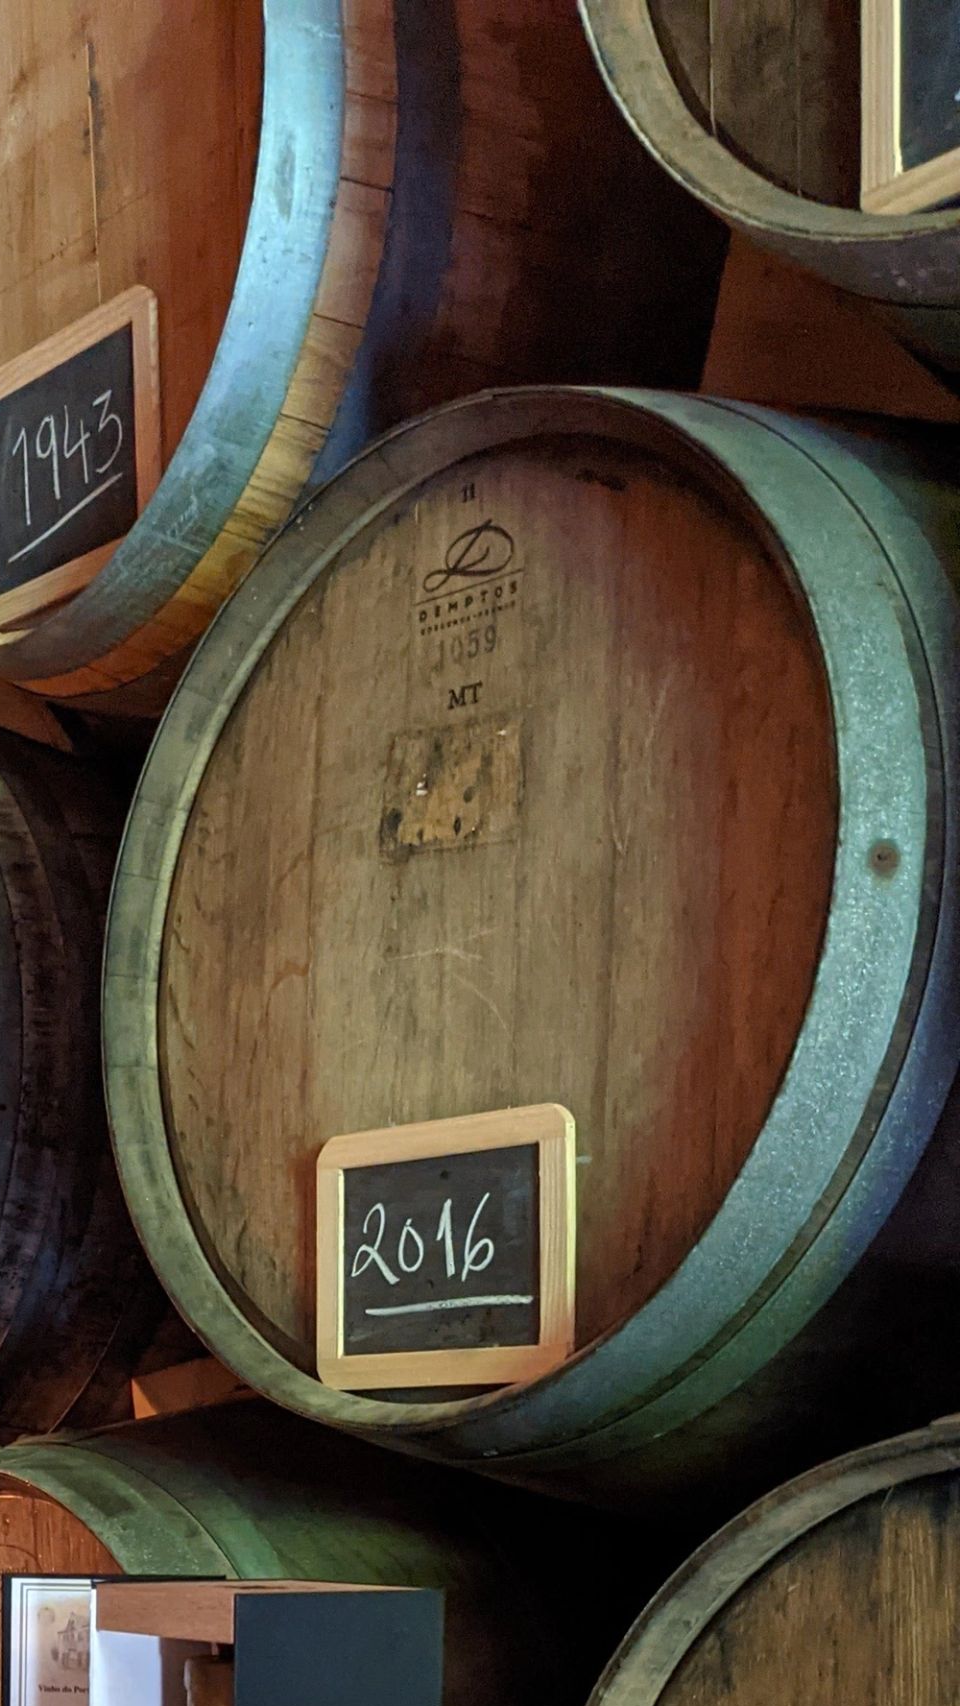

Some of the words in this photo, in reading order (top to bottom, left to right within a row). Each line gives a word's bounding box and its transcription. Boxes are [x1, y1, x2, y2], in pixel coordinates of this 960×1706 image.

[12, 388, 123, 526] 1943
[418, 580, 518, 623] DEMPTOS
[447, 680, 483, 710] MT
[350, 1191, 495, 1286] 2016
